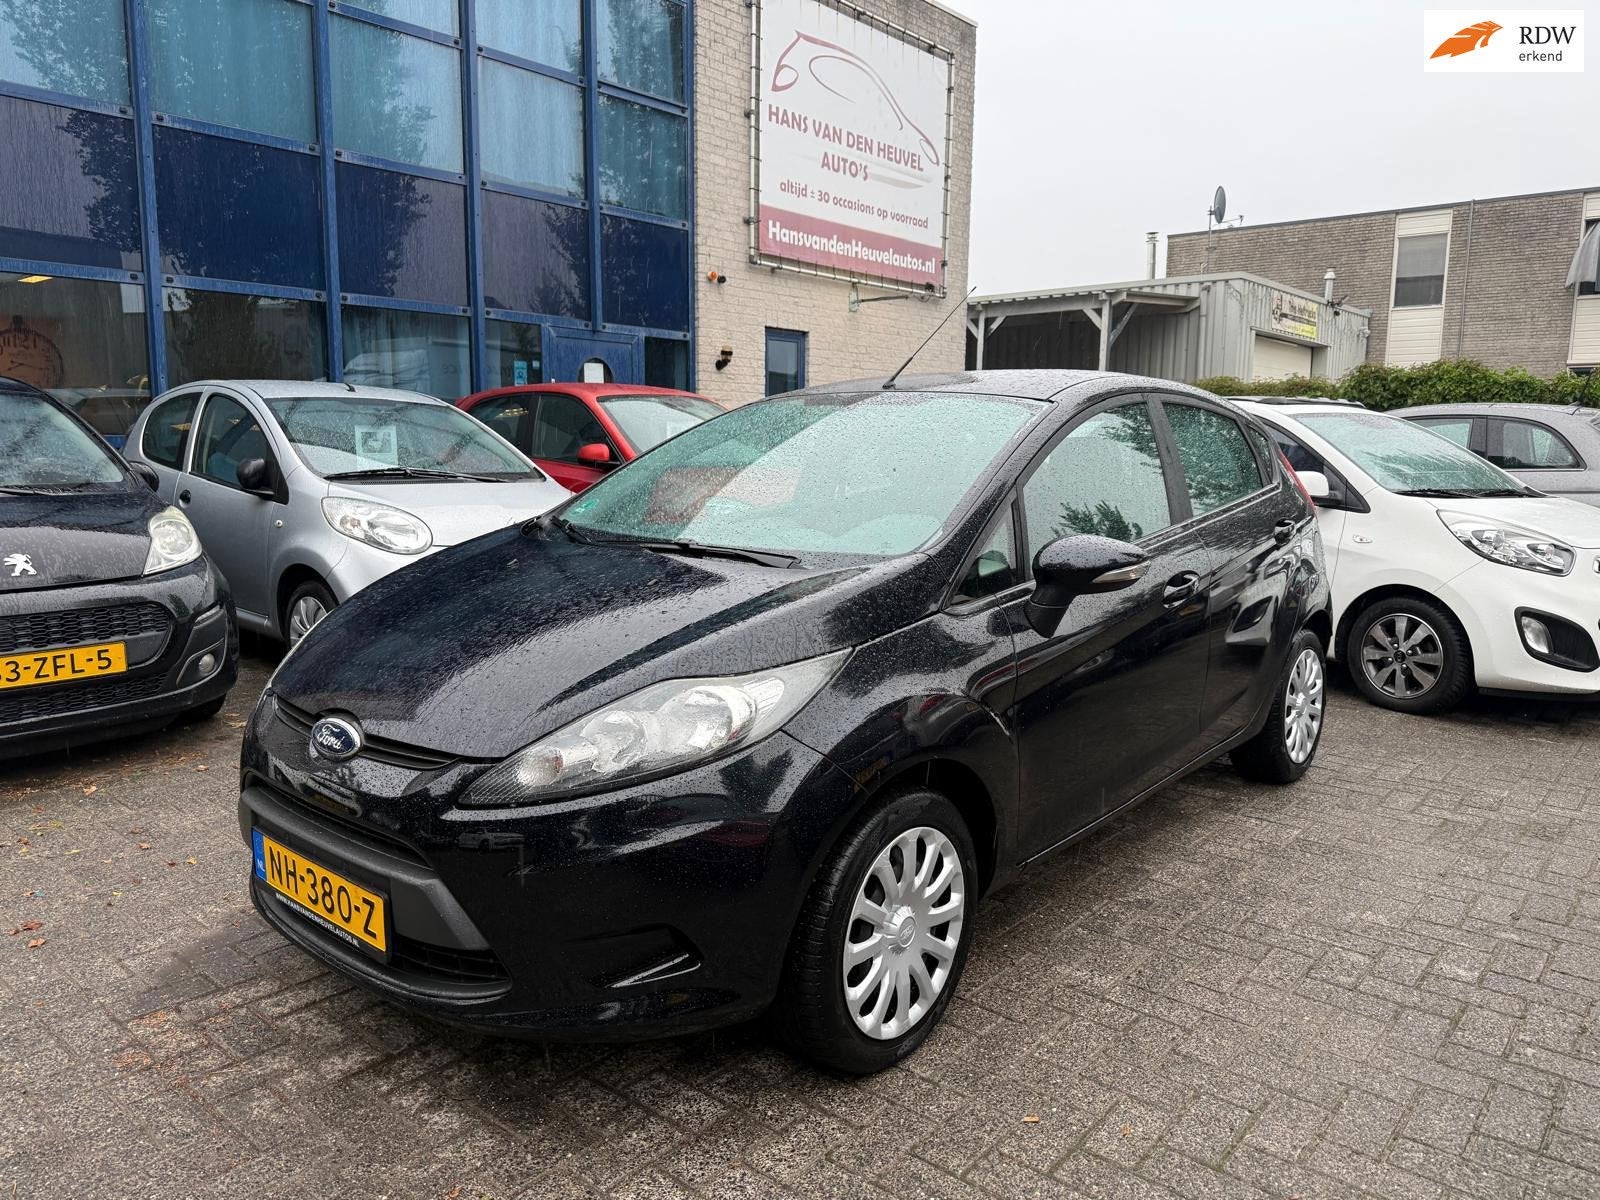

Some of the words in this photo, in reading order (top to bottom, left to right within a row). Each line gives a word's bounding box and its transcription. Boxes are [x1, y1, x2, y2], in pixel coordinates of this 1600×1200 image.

[768, 104, 809, 133] HANS
[812, 120, 842, 146] VAN
[846, 131, 874, 155] DEN
[877, 141, 924, 171] HEUVEL
[821, 151, 869, 182] AUTO'S
[780, 178, 808, 199] altijd
[817, 189, 830, 204] 30
[832, 195, 875, 216] occasions
[877, 207, 888, 220] op
[890, 211, 929, 228] voorraad
[768, 219, 936, 274] HansvandenHeuvelautos.nl
[0, 648, 113, 683] 3-ZFL-5
[317, 724, 346, 749] Ford
[268, 845, 378, 940] NH-380-Z
